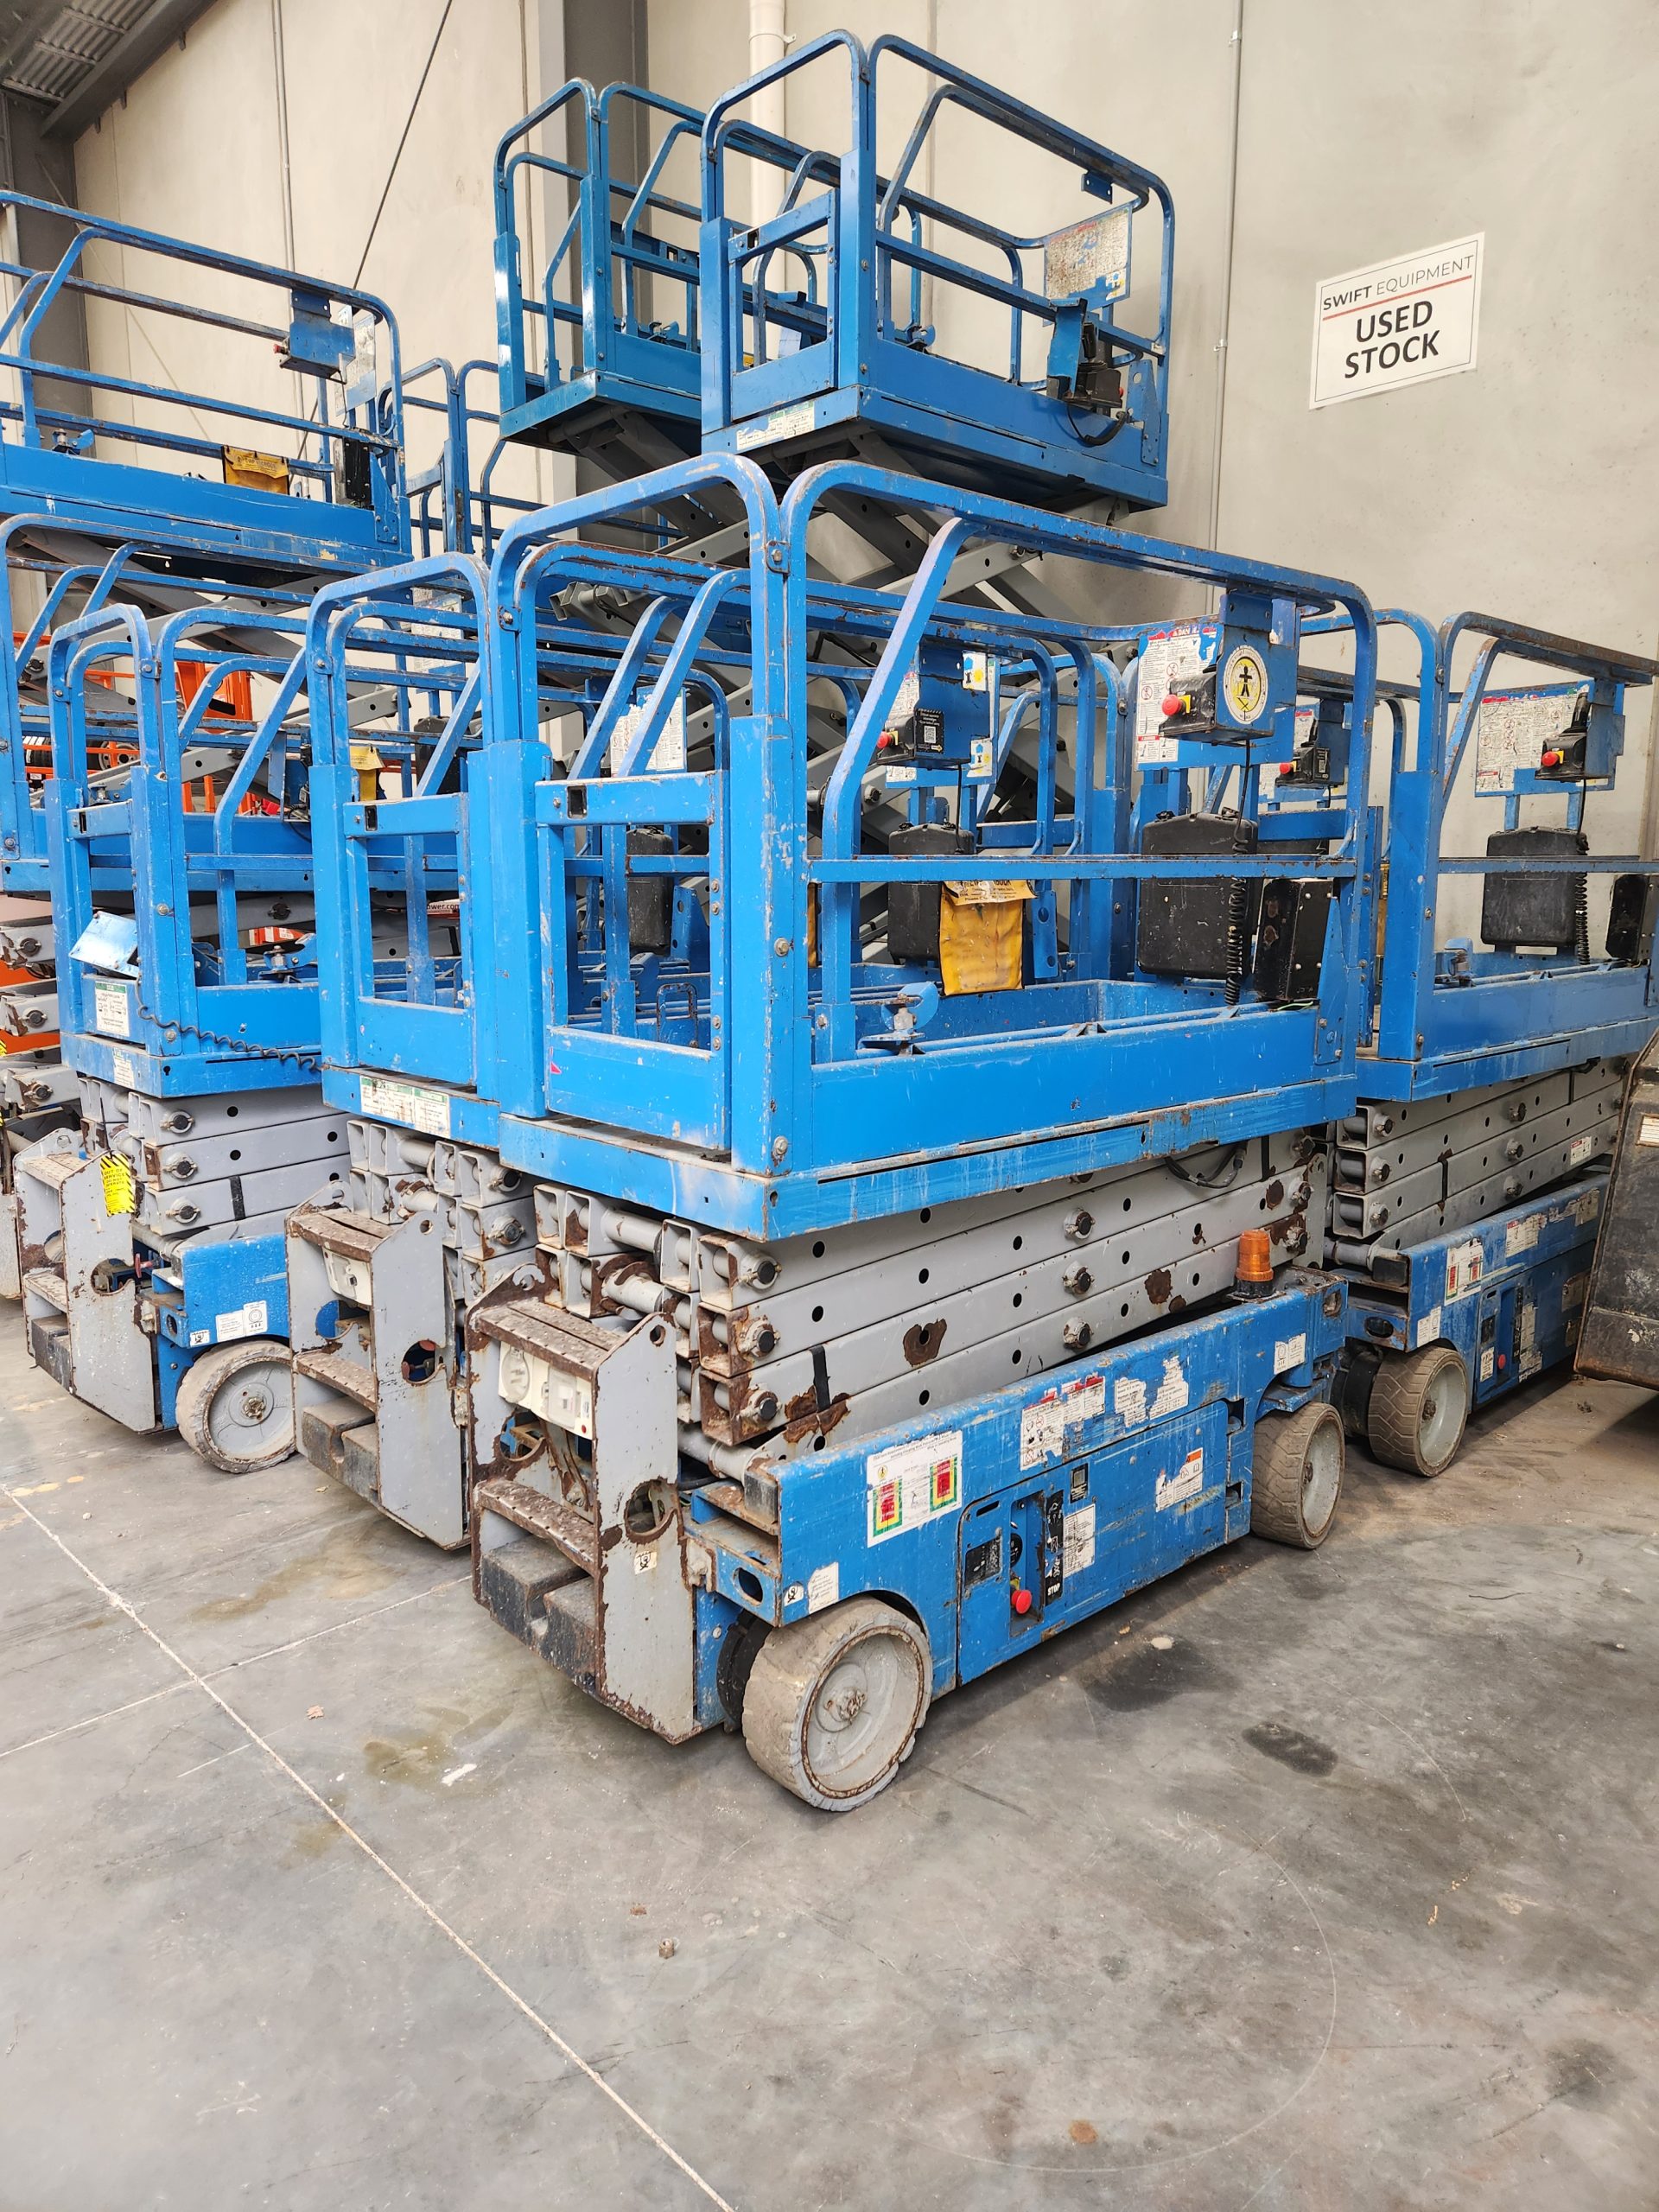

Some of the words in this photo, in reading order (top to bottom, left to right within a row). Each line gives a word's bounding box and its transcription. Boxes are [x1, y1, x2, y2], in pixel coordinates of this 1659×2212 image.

[1323, 285, 1372, 311] SWIFT
[1376, 255, 1474, 296] EQUIPMENT
[1356, 300, 1433, 343] USED
[1344, 329, 1440, 379] STOCK
[1047, 1582, 1061, 1596] STOP
